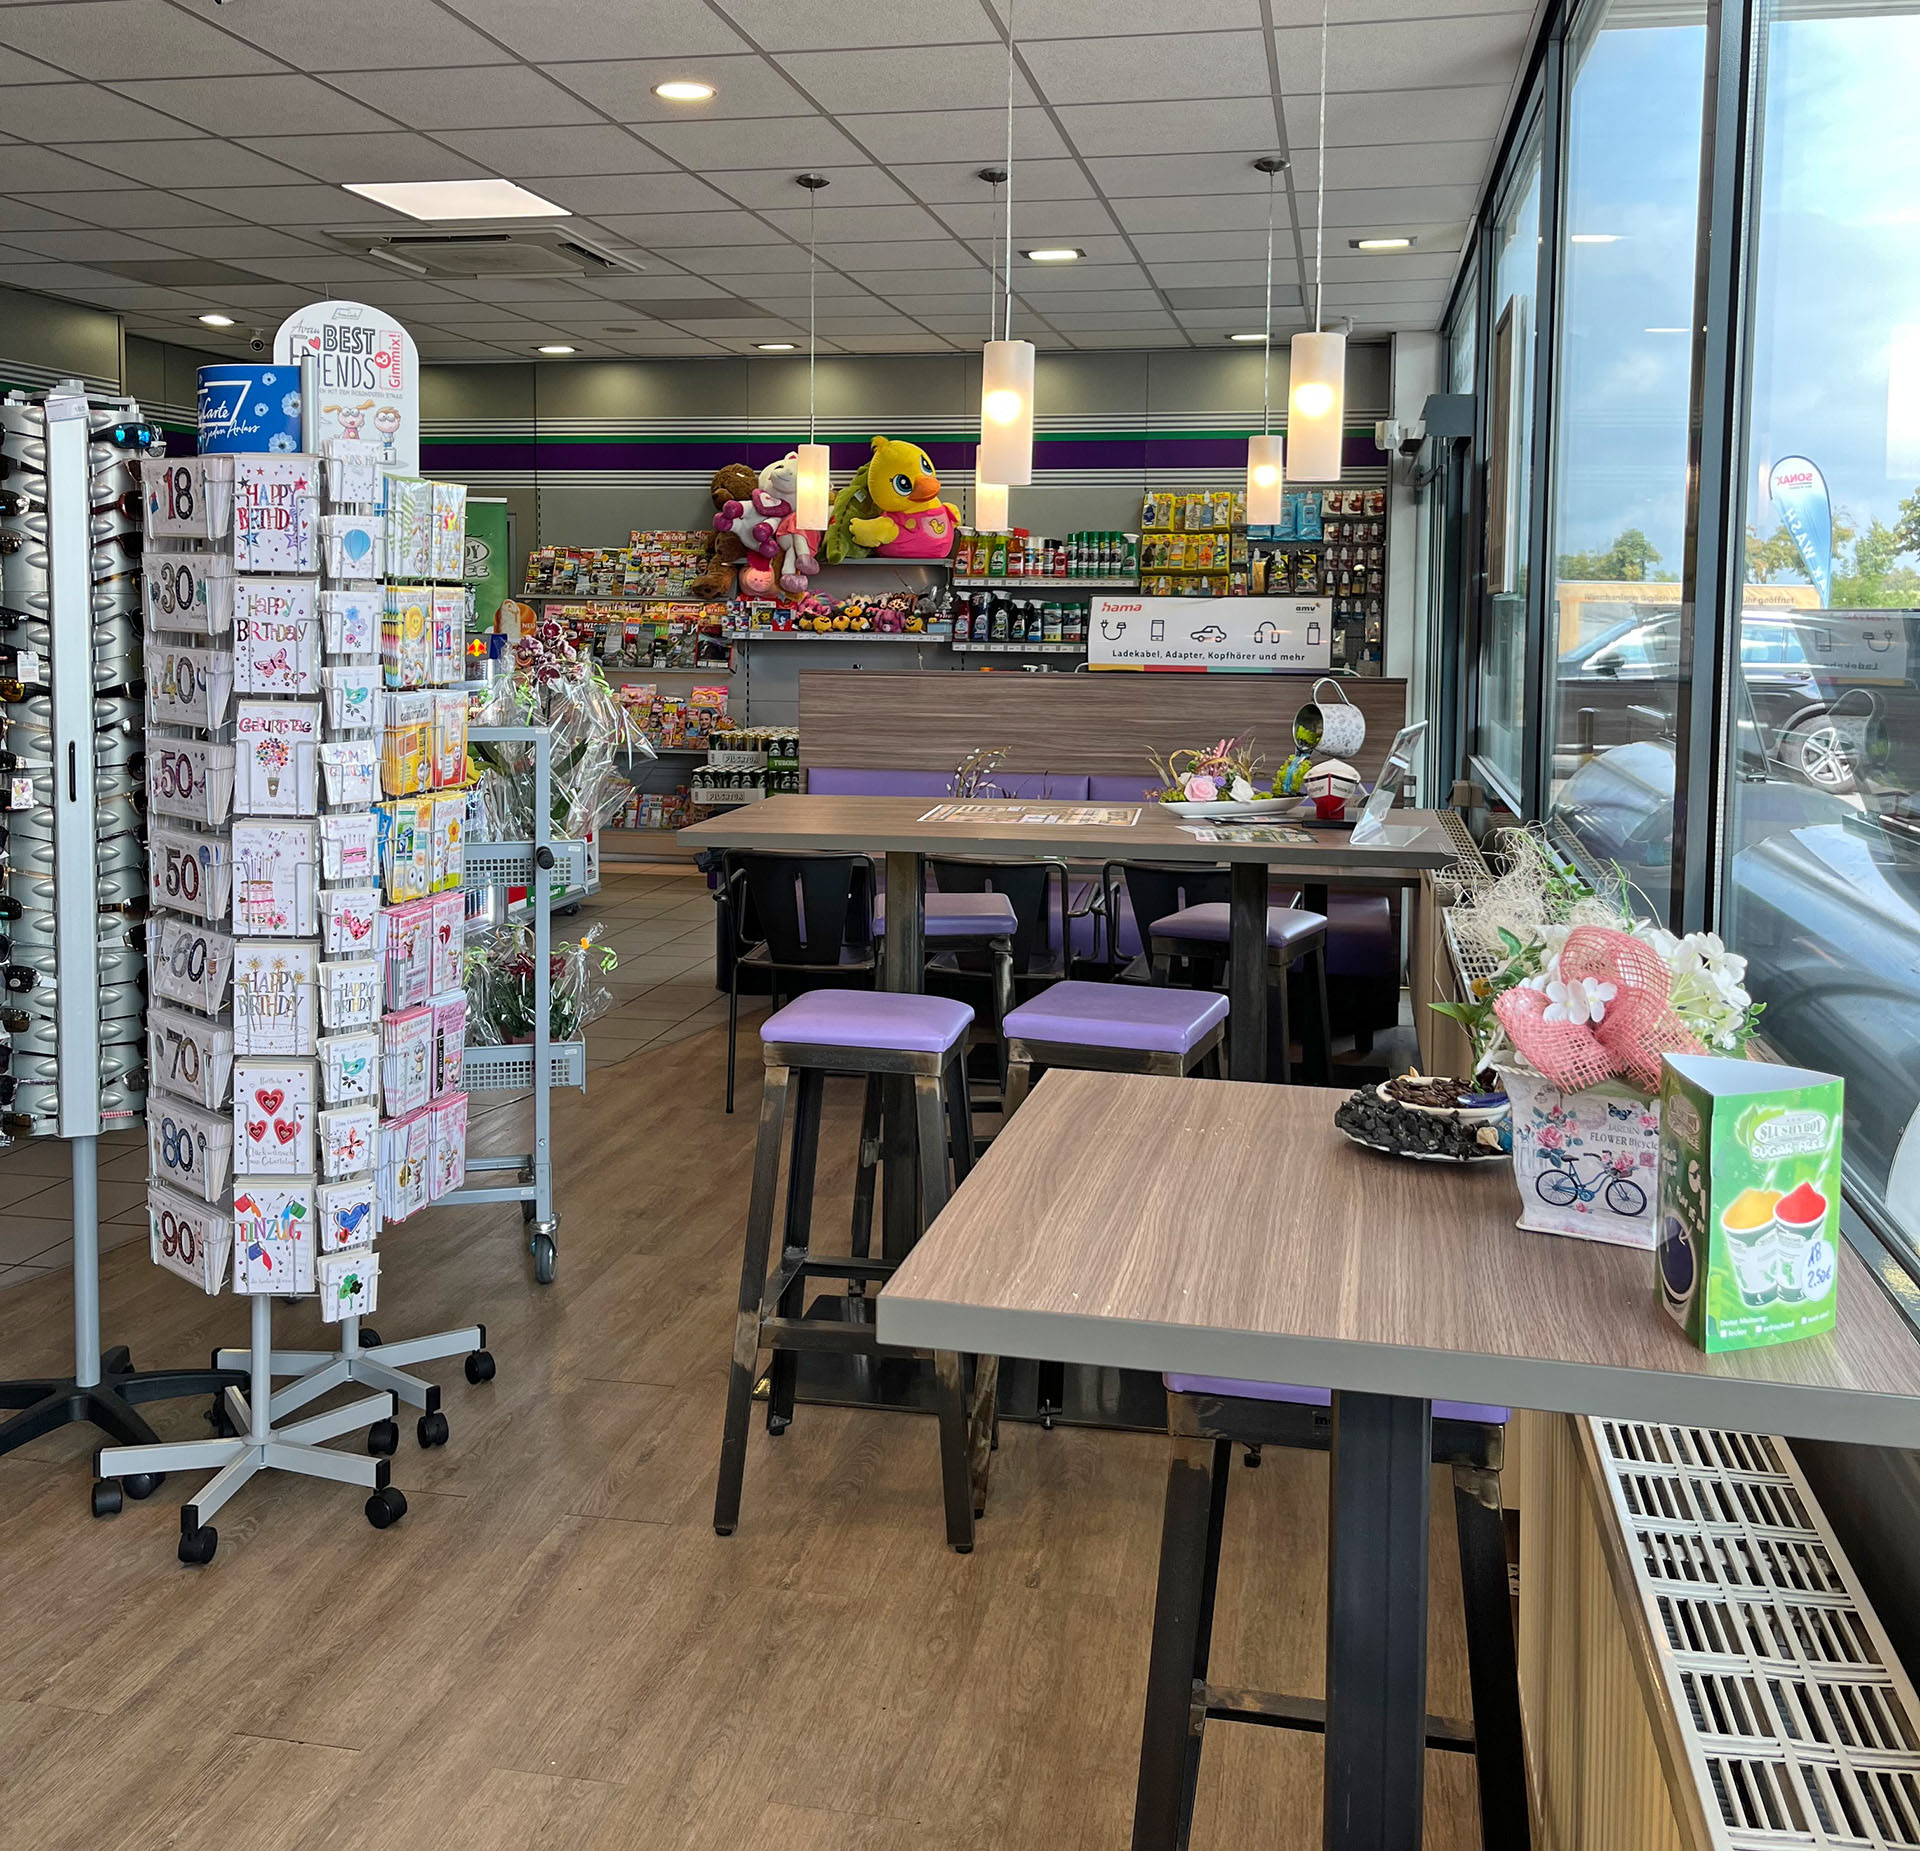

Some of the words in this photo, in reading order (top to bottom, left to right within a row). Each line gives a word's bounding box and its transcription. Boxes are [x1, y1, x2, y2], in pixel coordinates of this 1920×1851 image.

[323, 324, 376, 355] BEST
[388, 334, 401, 388] Gimmix!
[163, 467, 194, 520] 18
[245, 483, 297, 507] HAPPY
[161, 563, 194, 614] 30
[1101, 602, 1143, 612] hama
[162, 655, 195, 704] 40
[1112, 649, 1163, 658] Ladekabel,
[1165, 651, 1205, 660] Adapter,
[1207, 651, 1256, 661] Kopfhörer
[1259, 652, 1277, 660] und
[1280, 653, 1305, 661] mehr
[238, 717, 312, 735] GEBURTSTAG
[160, 749, 193, 798] 50
[165, 845, 199, 900] 50
[171, 933, 207, 982] 60
[244, 971, 298, 993] HAPPY
[166, 1027, 199, 1083] 70
[162, 1117, 194, 1172] 80
[1590, 1131, 1627, 1146] FLOWER
[161, 1210, 195, 1264] 90
[240, 1216, 301, 1242] EINZUG
